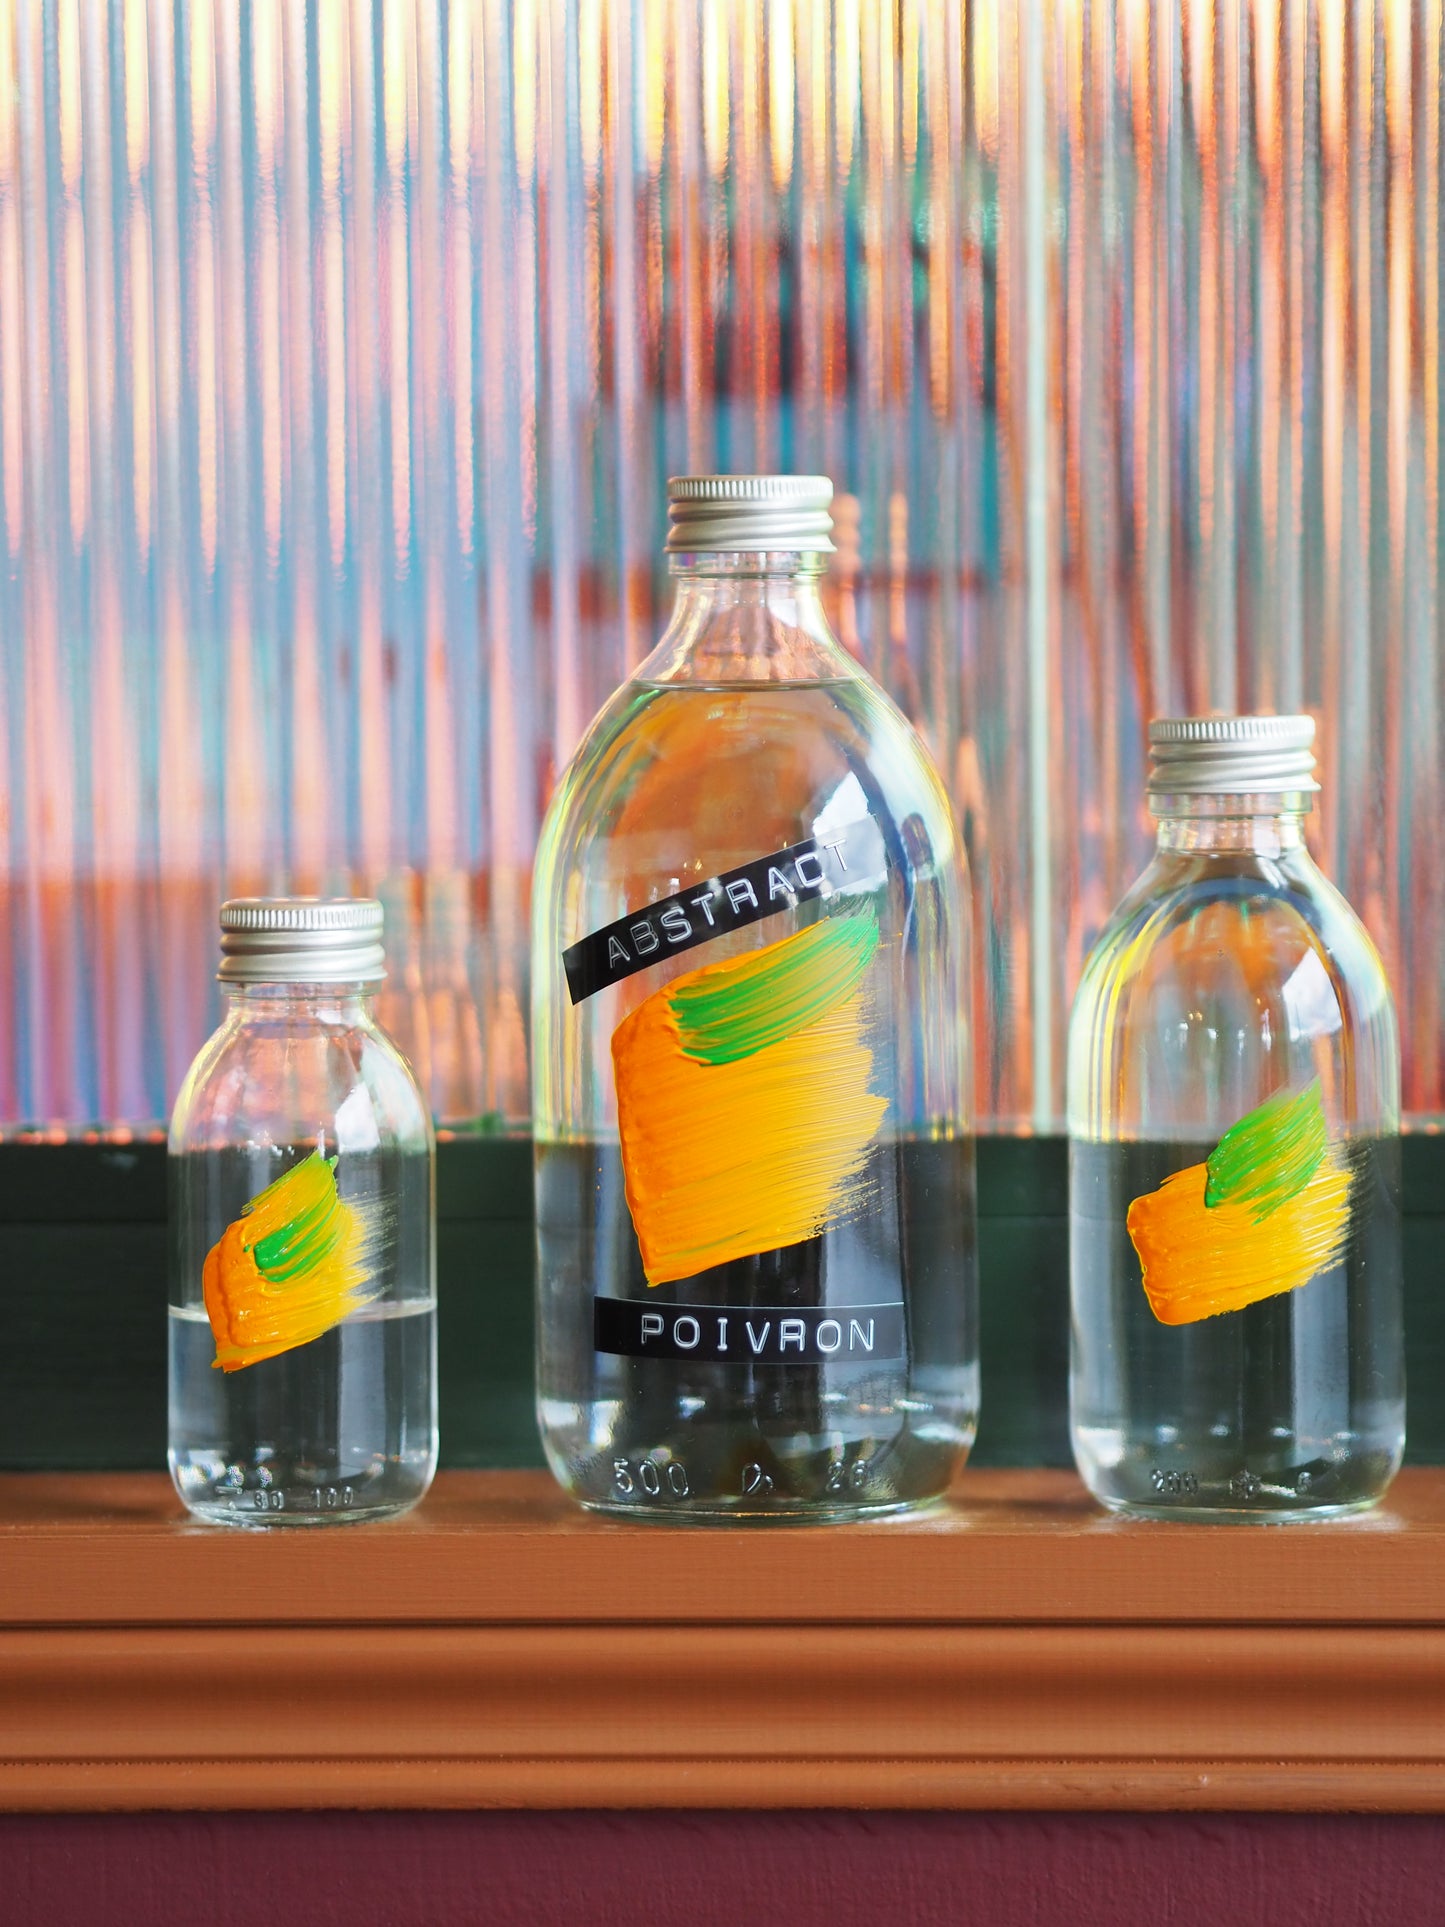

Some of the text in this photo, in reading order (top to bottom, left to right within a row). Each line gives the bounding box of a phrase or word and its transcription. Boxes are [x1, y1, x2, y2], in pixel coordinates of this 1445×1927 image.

[607, 838, 849, 970] ABSTRACT
[640, 1312, 876, 1354] POIVRON
[613, 1457, 690, 1497] 500
